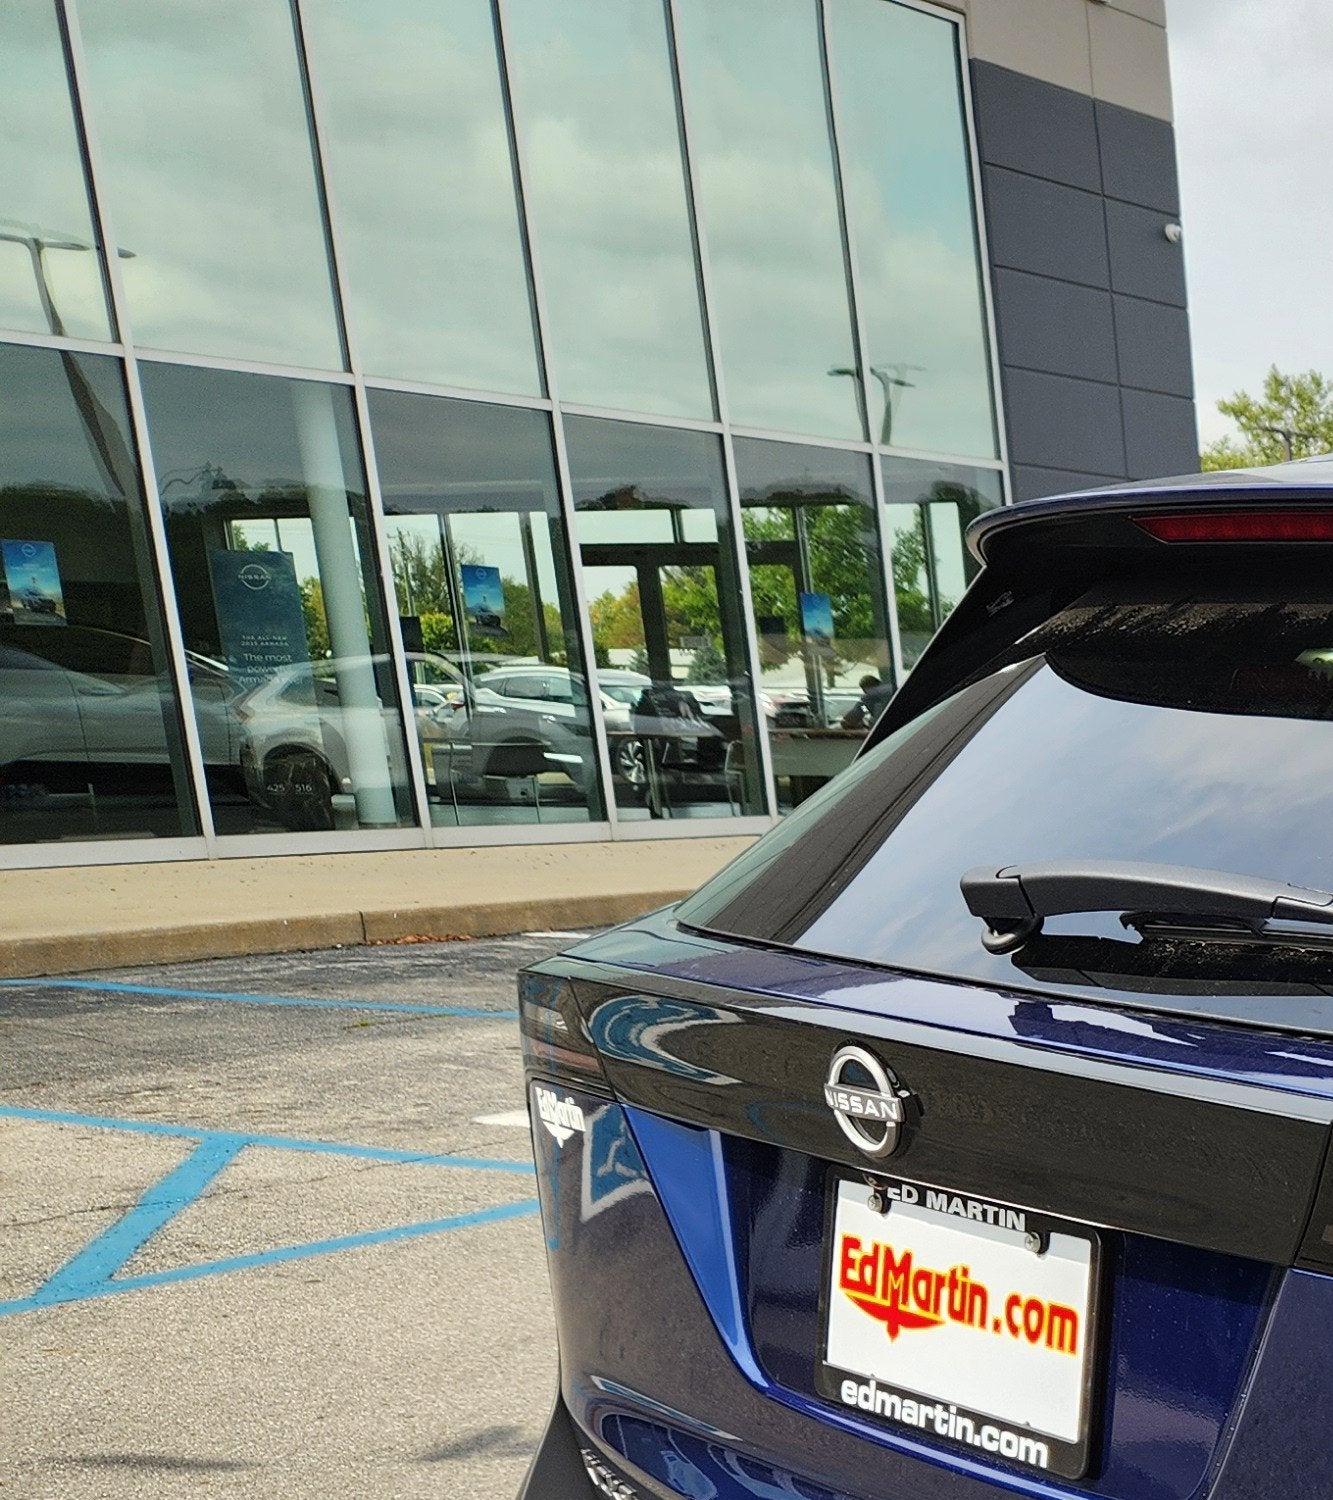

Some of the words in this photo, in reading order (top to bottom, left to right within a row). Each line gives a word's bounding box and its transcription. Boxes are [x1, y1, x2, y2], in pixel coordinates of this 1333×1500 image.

[243, 653, 263, 661] The
[265, 653, 292, 663] most
[824, 1089, 899, 1121] NISSAN
[926, 1187, 1027, 1232] MARTIN
[838, 1232, 1079, 1357] EdMartin.com
[840, 1378, 1049, 1469] edmartin.com
